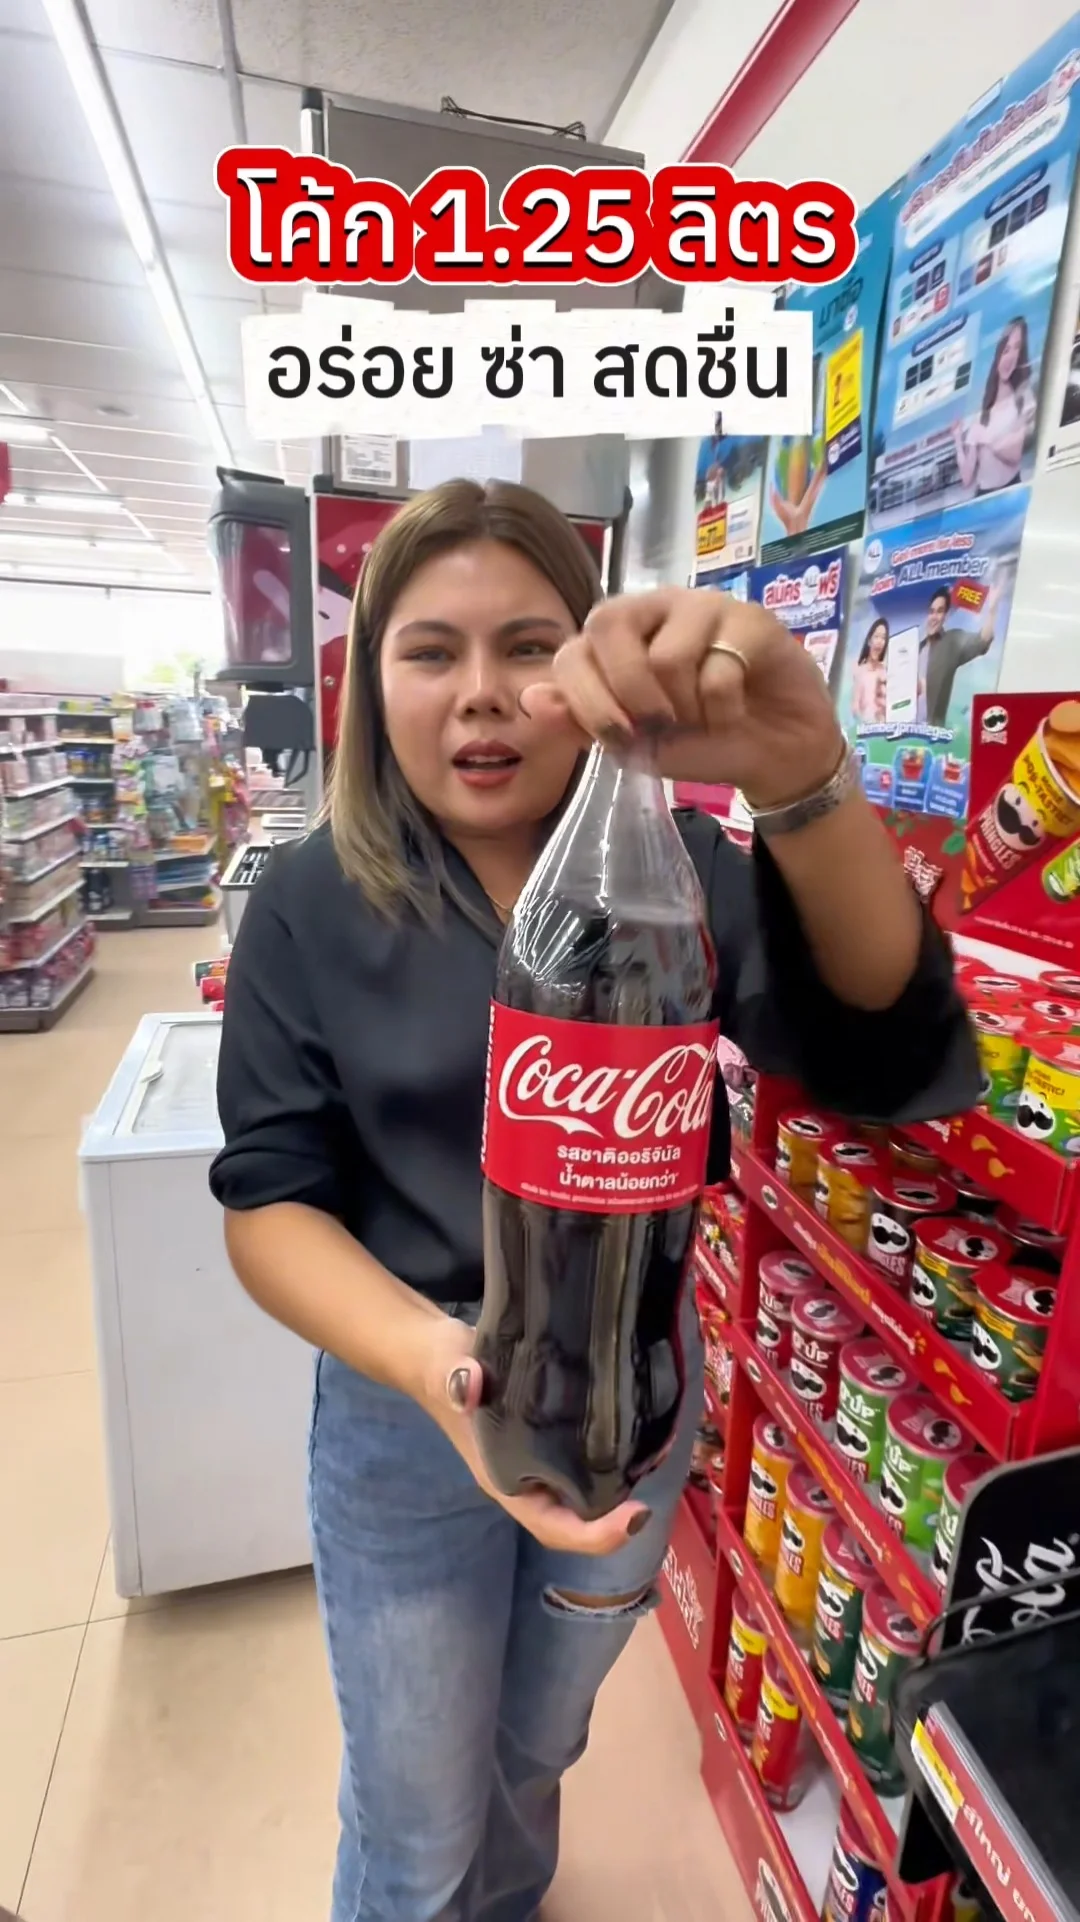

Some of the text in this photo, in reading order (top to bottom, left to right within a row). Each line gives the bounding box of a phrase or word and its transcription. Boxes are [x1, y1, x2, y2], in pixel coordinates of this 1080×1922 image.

[898, 560, 924, 587] ALL
[924, 553, 989, 581] member
[957, 586, 982, 605] FREE
[979, 805, 1022, 871] PRINGLES
[557, 1144, 681, 1165] รสชาติออริจินัล
[559, 1162, 679, 1191] น้ำตาลน้อยกว่า
